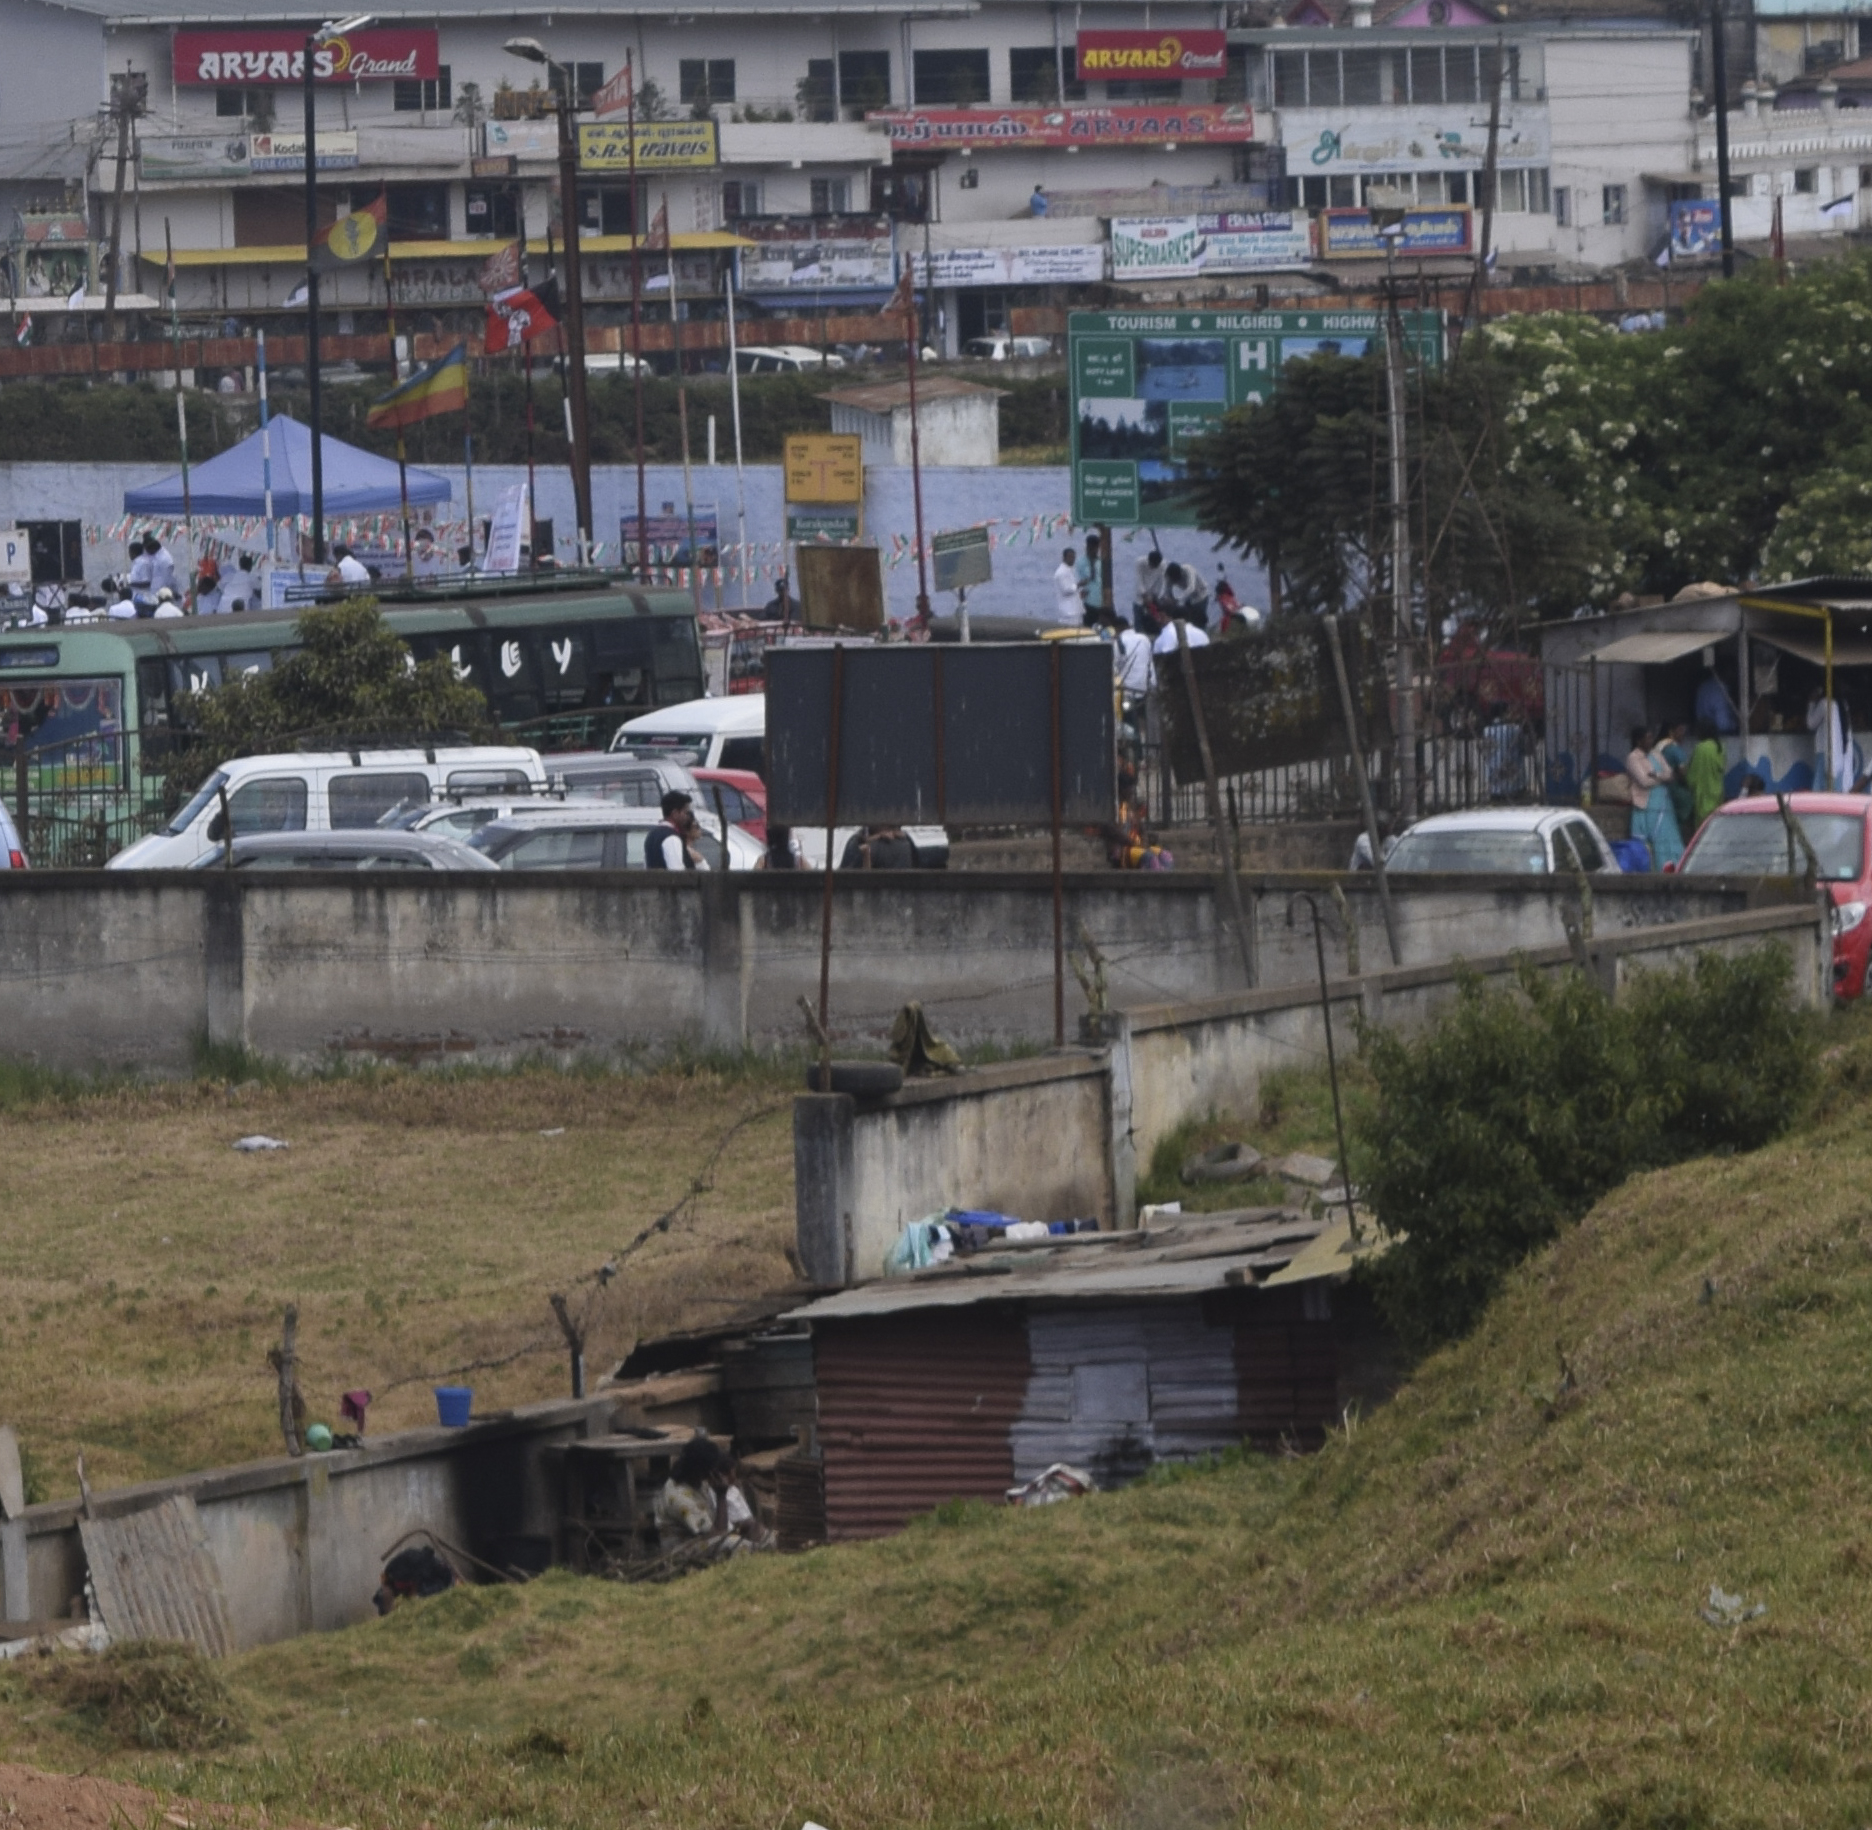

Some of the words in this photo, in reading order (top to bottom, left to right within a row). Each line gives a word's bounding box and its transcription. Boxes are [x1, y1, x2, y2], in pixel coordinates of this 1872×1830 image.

[348, 49, 417, 78] Grand
[1084, 49, 1173, 69] ARYAAS
[1069, 116, 1206, 136] ARYAAS
[639, 140, 709, 157] travels
[1113, 230, 1196, 267] SUPERMARKET
[1107, 316, 1177, 330] TOURISM
[1216, 315, 1283, 329] NILGIRIS
[6, 542, 16, 565] P
